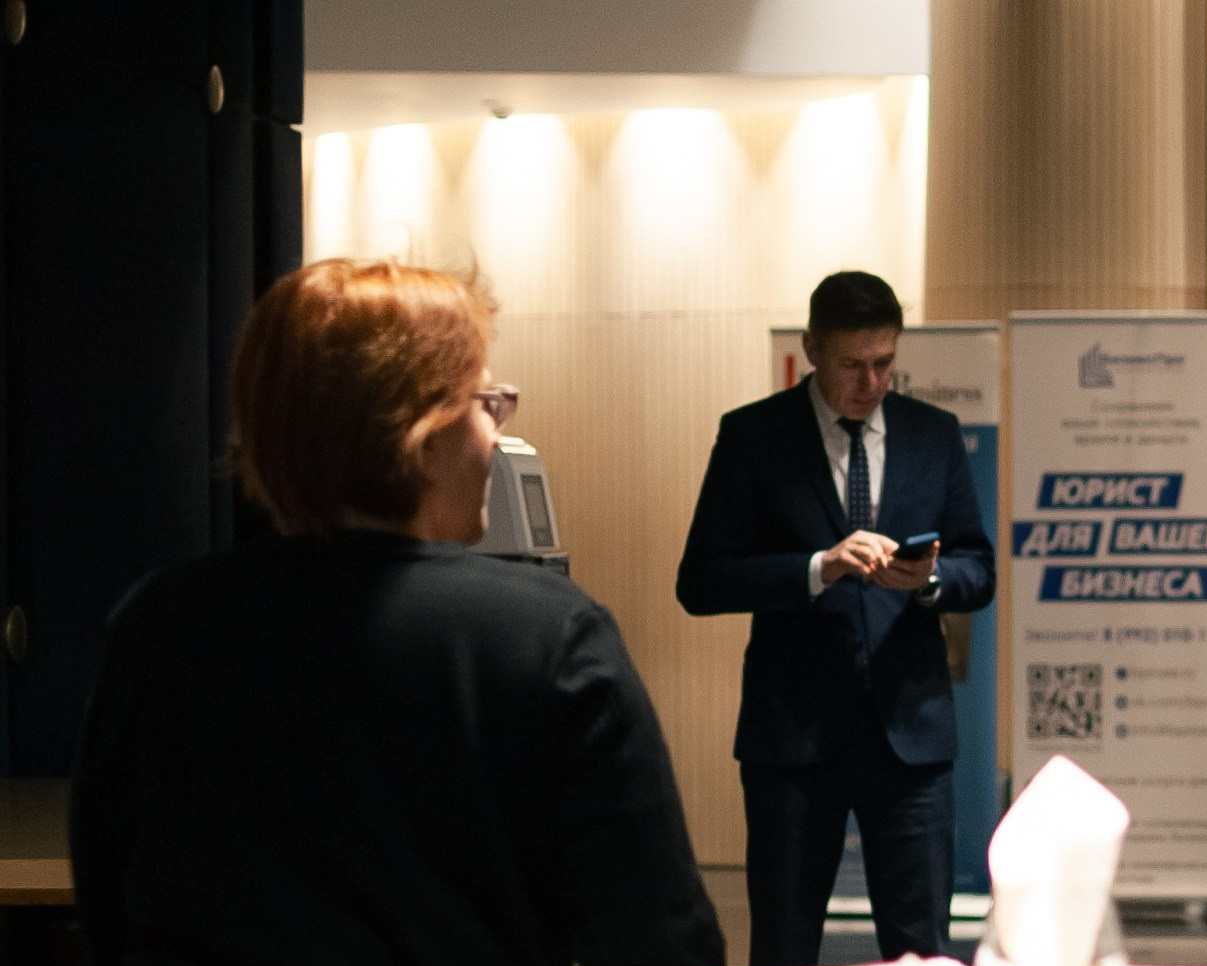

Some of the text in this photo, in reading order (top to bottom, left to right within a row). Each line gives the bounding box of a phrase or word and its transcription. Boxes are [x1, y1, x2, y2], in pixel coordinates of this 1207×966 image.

[1051, 476, 1169, 506] ЮРИСТ
[1022, 523, 1094, 556] ДЛЯ
[1060, 571, 1203, 598] БИЗНЕСА
